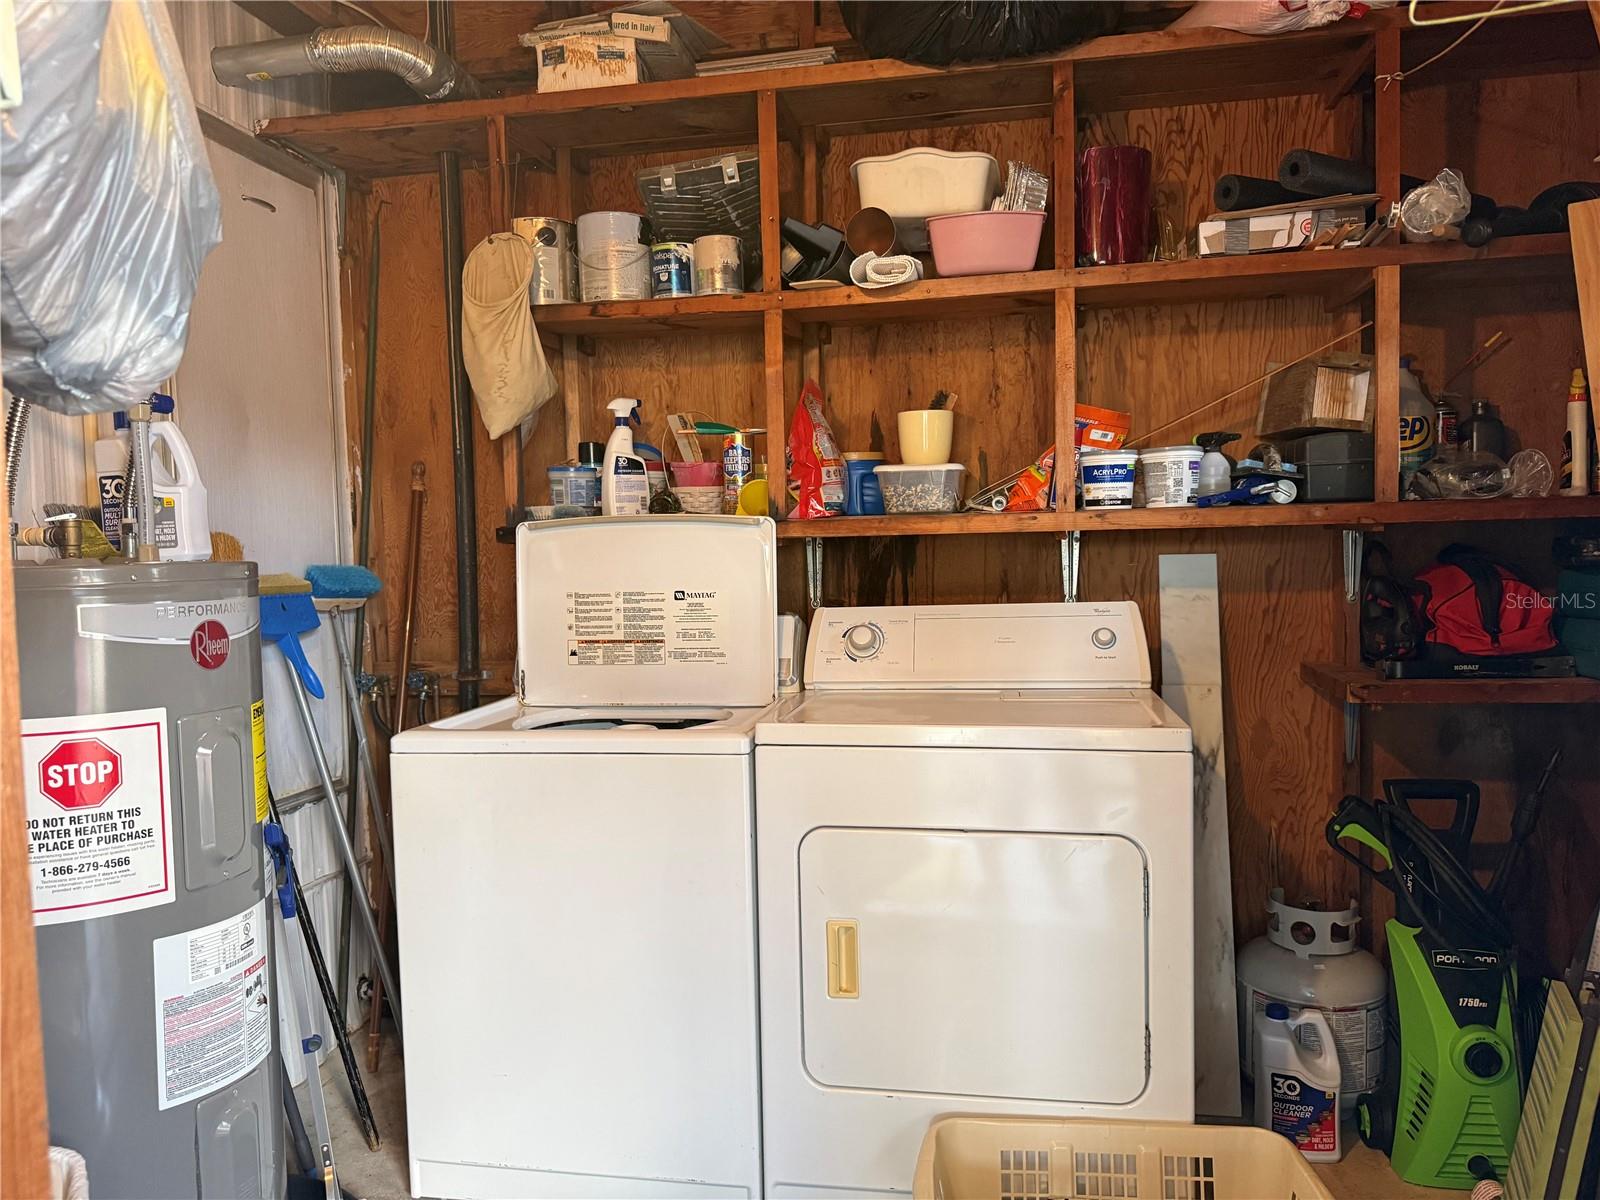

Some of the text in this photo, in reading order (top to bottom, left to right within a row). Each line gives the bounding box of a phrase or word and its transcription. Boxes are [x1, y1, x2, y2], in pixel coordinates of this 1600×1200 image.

[631, 22, 638, 30] in
[640, 24, 655, 33] Italy
[1400, 417, 1425, 441] ep
[617, 457, 628, 465] 30
[195, 622, 229, 662] Rheem
[47, 760, 113, 788] STOP
[43, 817, 65, 828] NOT
[69, 811, 113, 826] RETURN
[117, 807, 141, 819] THIS
[32, 819, 135, 841] WATER HEATER TO
[38, 840, 74, 853] PLACE
[78, 838, 92, 848] OF
[97, 828, 154, 846] PURCHASE
[41, 857, 130, 877] 1-866-279-4566
[1273, 1077, 1300, 1096] 30
[1273, 1102, 1314, 1112] OUTDOOR
[1273, 1107, 1312, 1118] CLEANER
